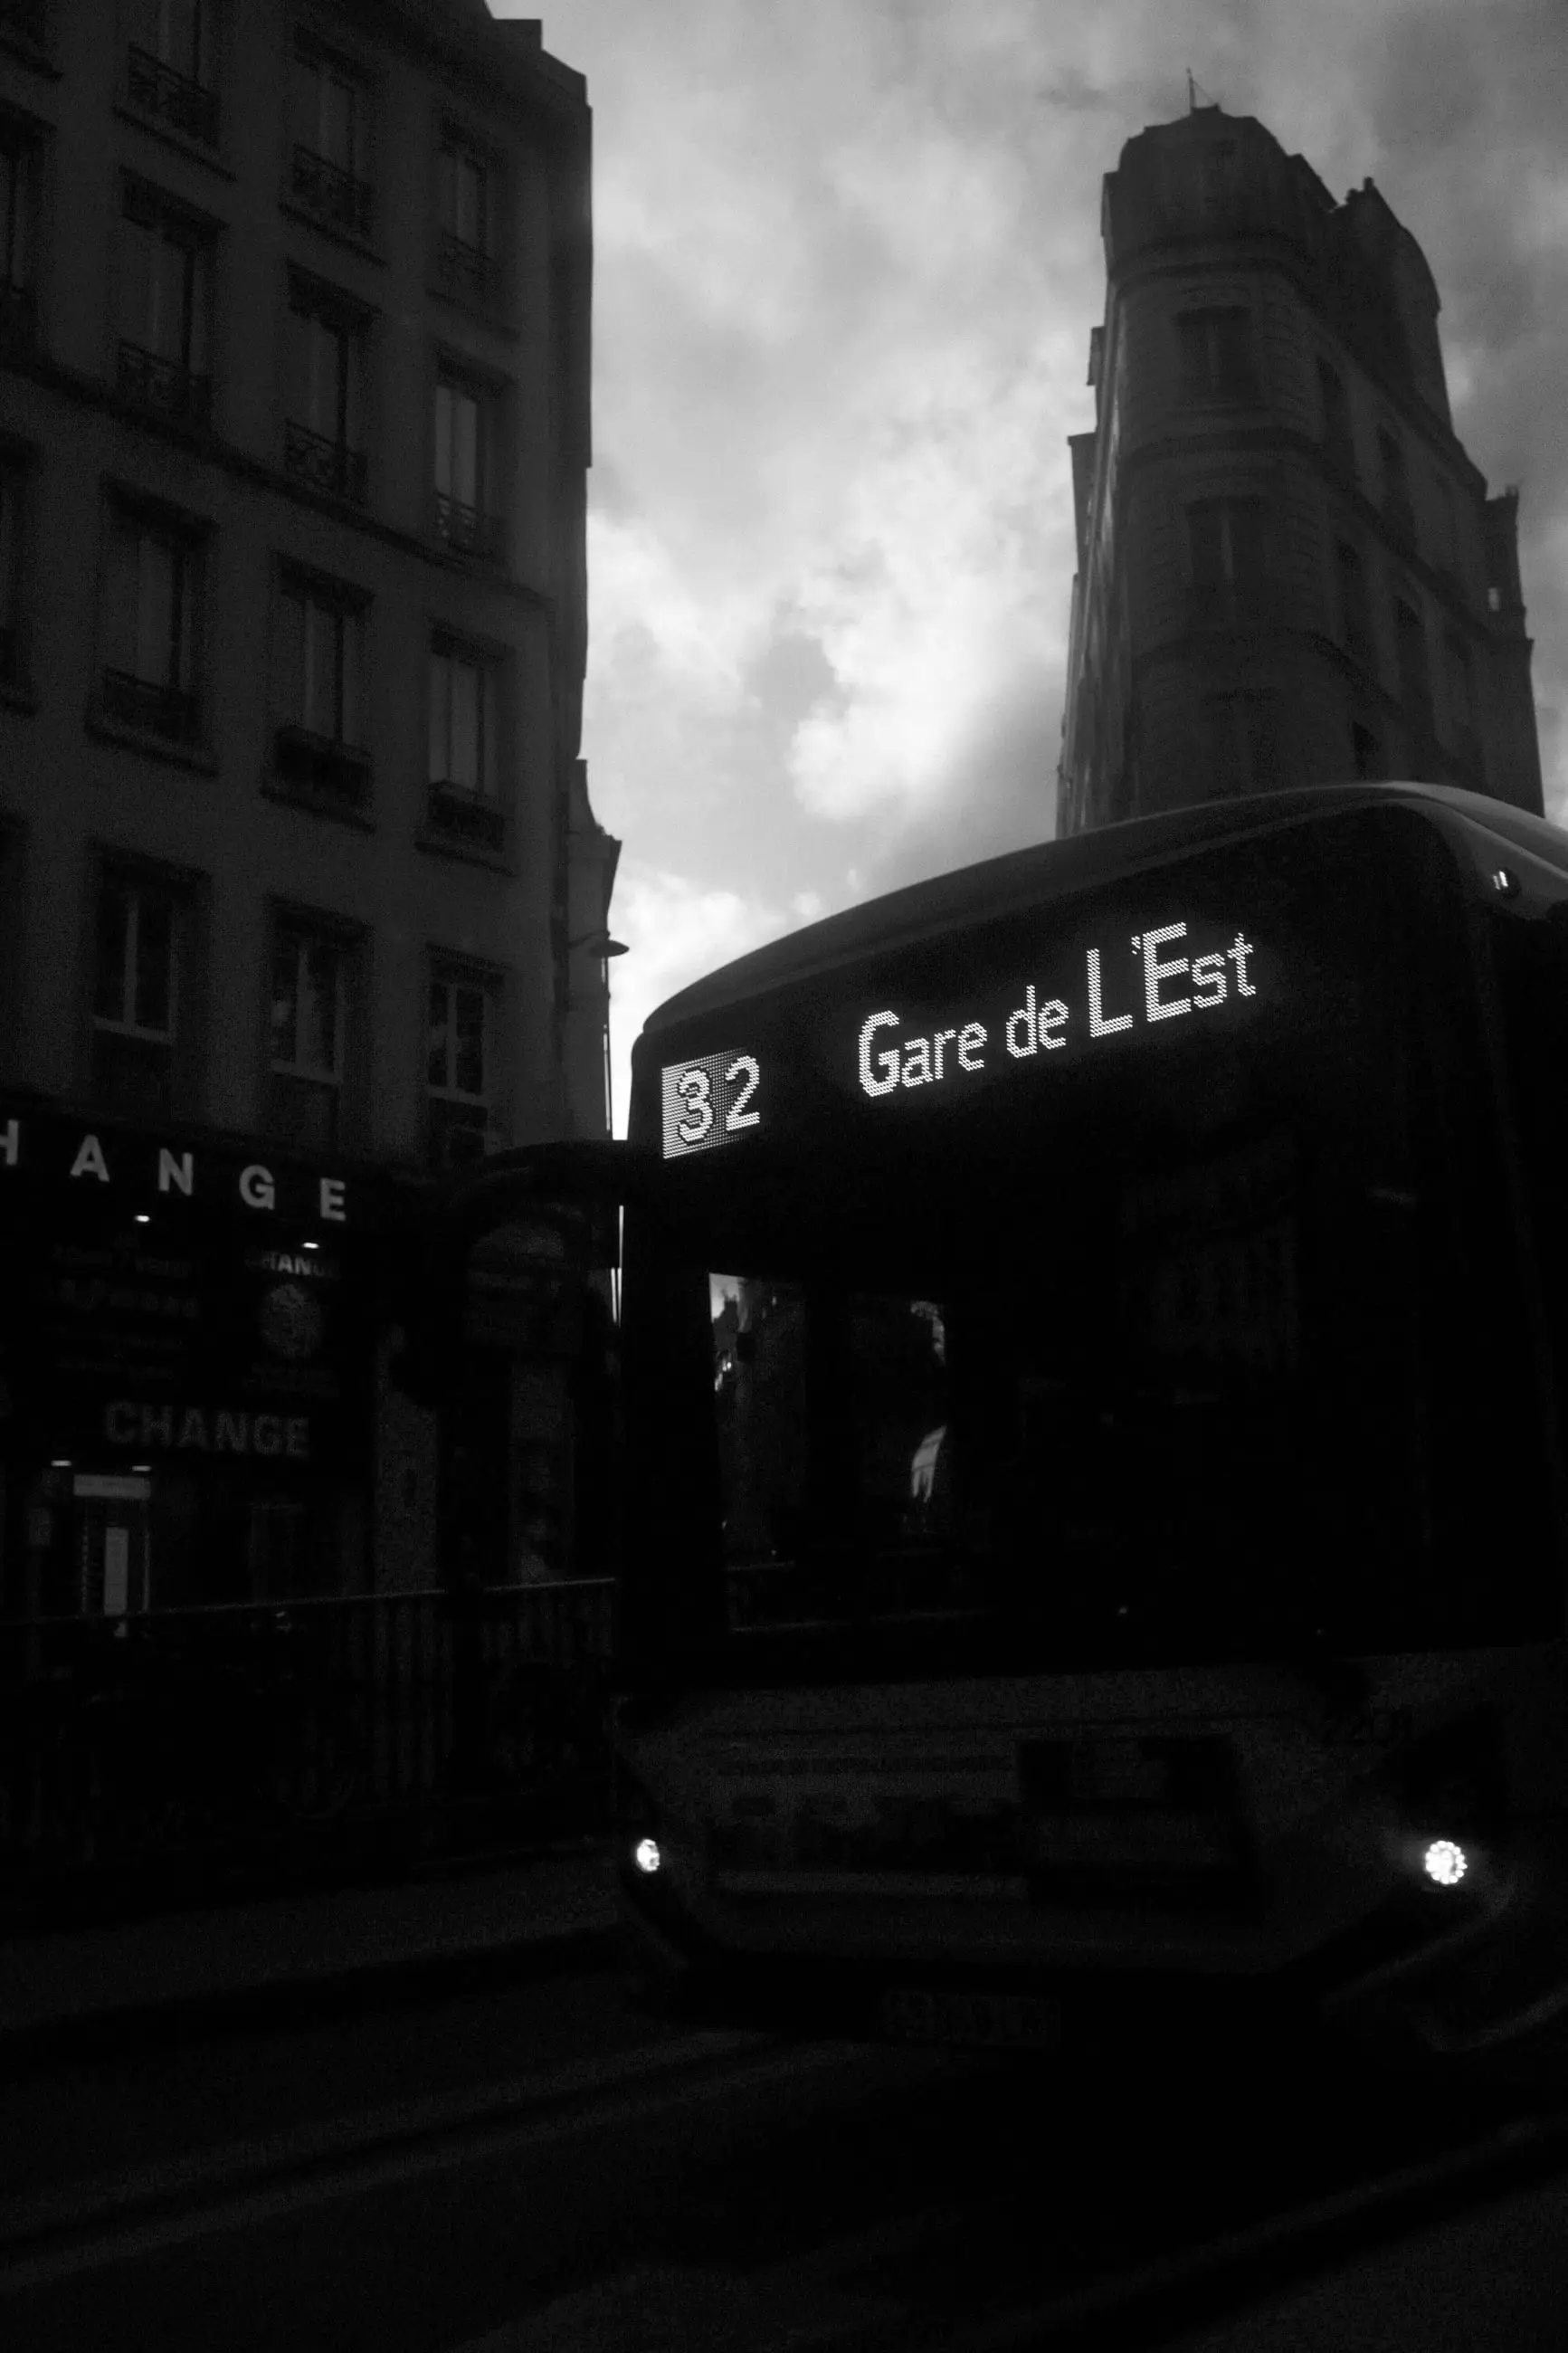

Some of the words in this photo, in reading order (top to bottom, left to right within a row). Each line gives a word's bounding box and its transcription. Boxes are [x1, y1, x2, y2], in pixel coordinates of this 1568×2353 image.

[858, 1010, 988, 1098] Gare
[1005, 985, 1070, 1058] de
[677, 1054, 761, 1143] 32
[103, 1399, 309, 1458] CHANGE
